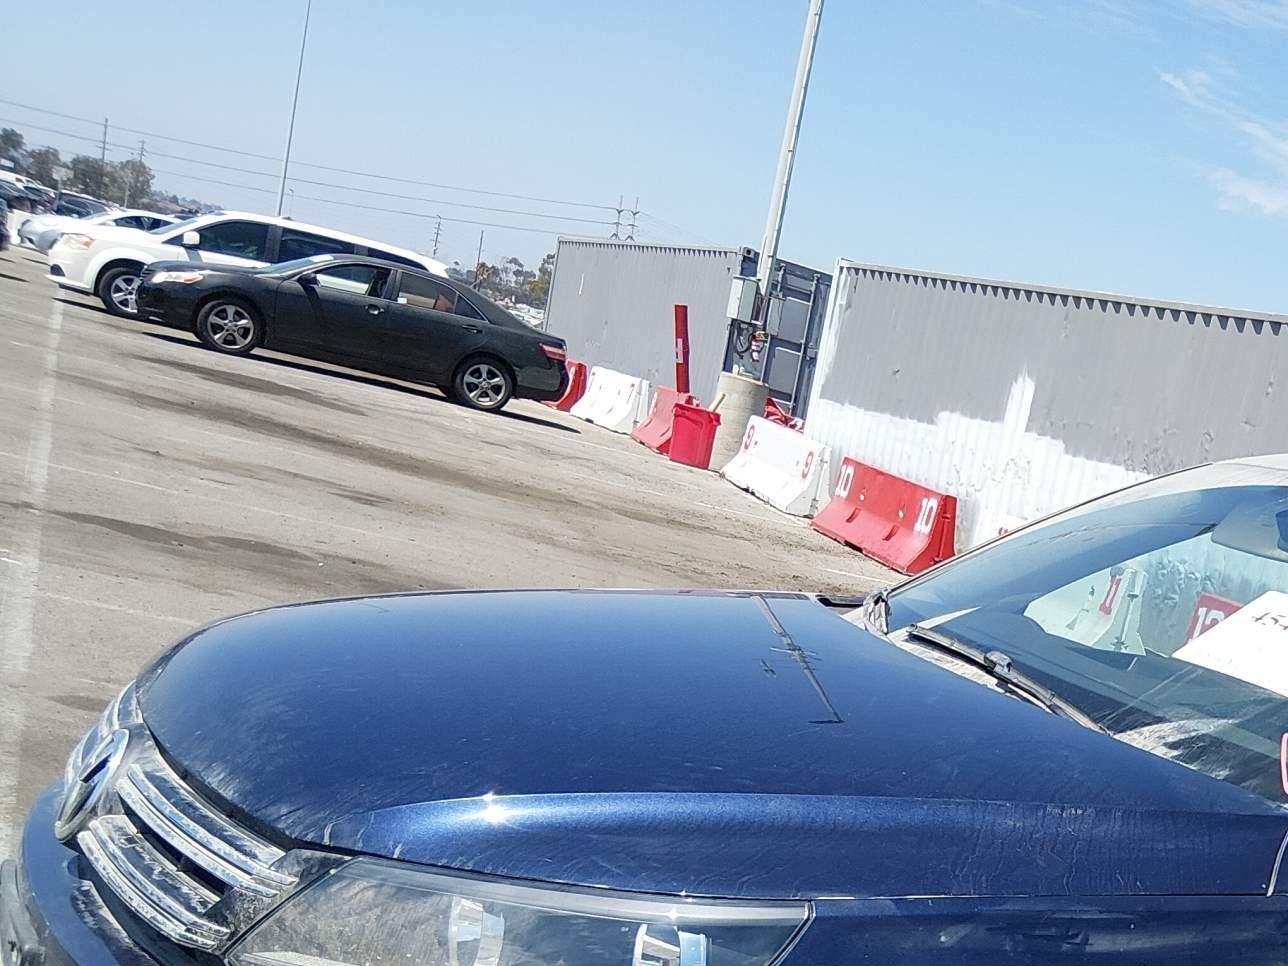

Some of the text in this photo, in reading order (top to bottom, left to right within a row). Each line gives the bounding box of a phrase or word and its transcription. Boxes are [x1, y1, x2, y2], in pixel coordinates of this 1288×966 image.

[744, 424, 755, 450] 9
[801, 451, 815, 479] 9
[835, 464, 855, 497] 10
[917, 497, 938, 535] 10
